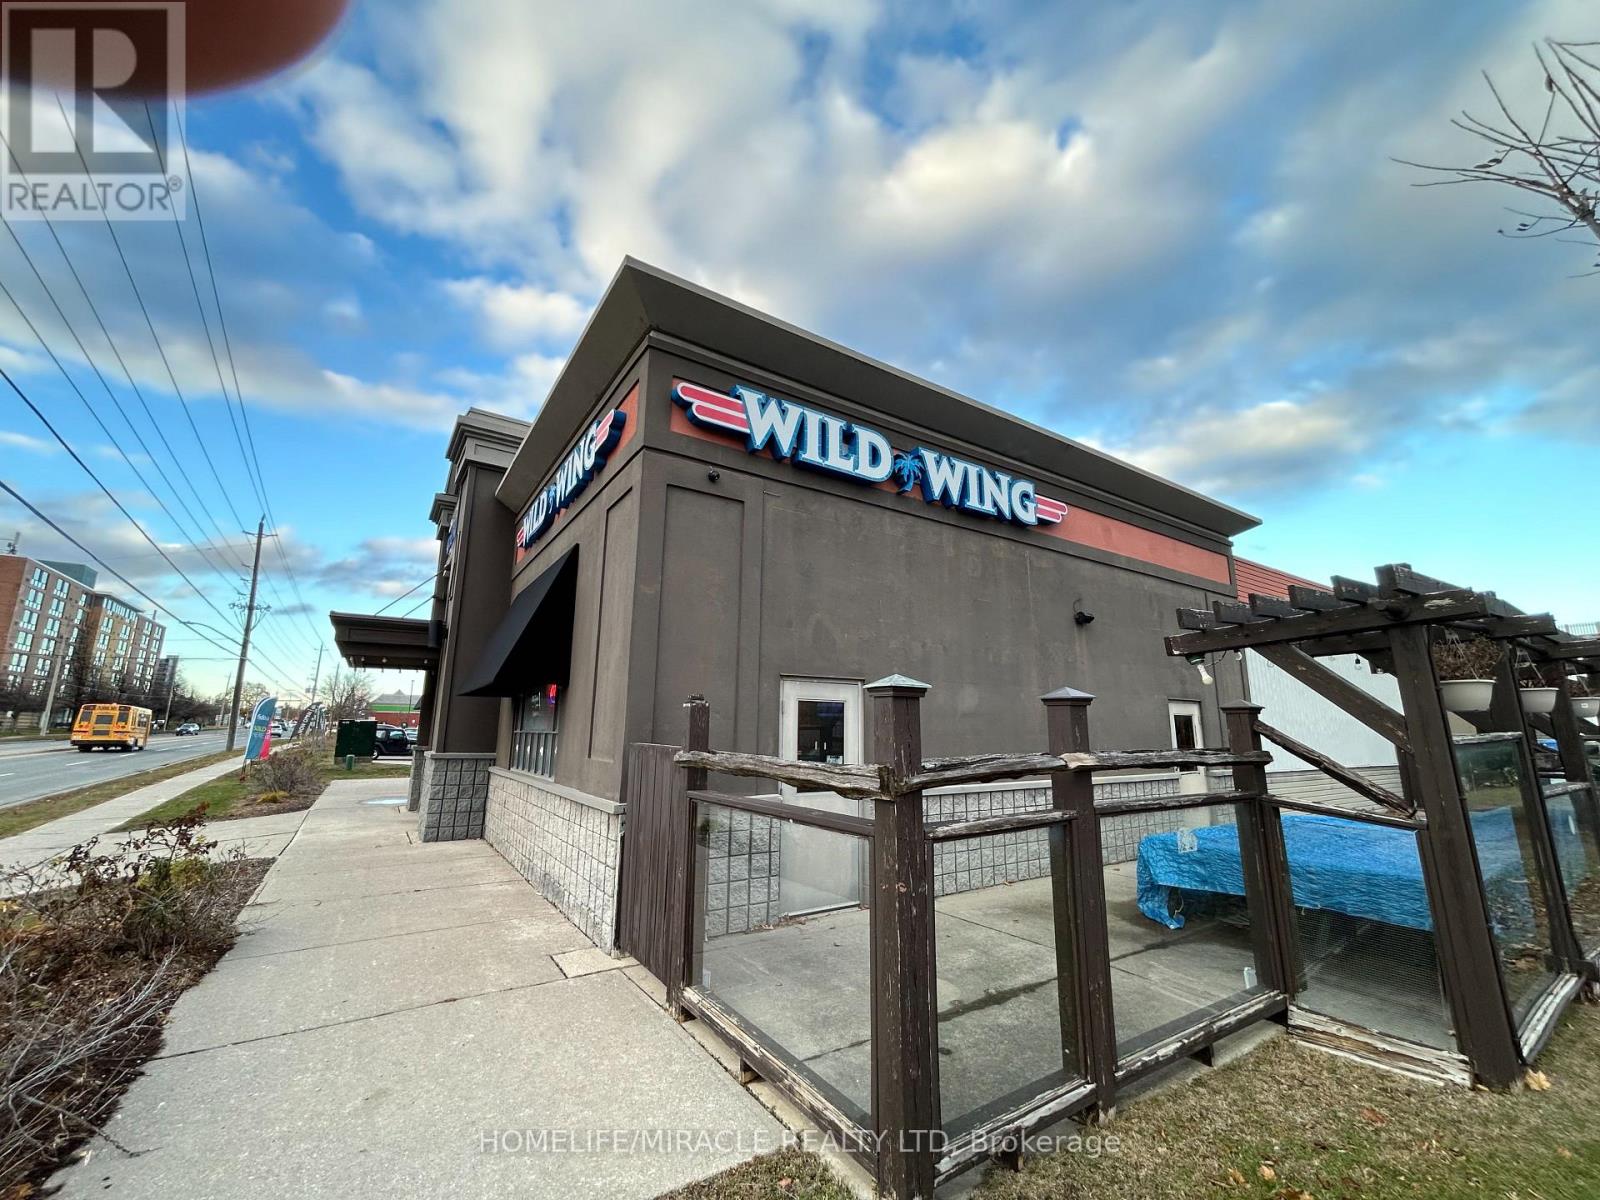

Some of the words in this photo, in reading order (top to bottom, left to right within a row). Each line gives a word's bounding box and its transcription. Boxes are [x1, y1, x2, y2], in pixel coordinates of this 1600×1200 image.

[556, 421, 598, 508] WING
[731, 384, 895, 484] WILD
[917, 446, 1038, 526] WING
